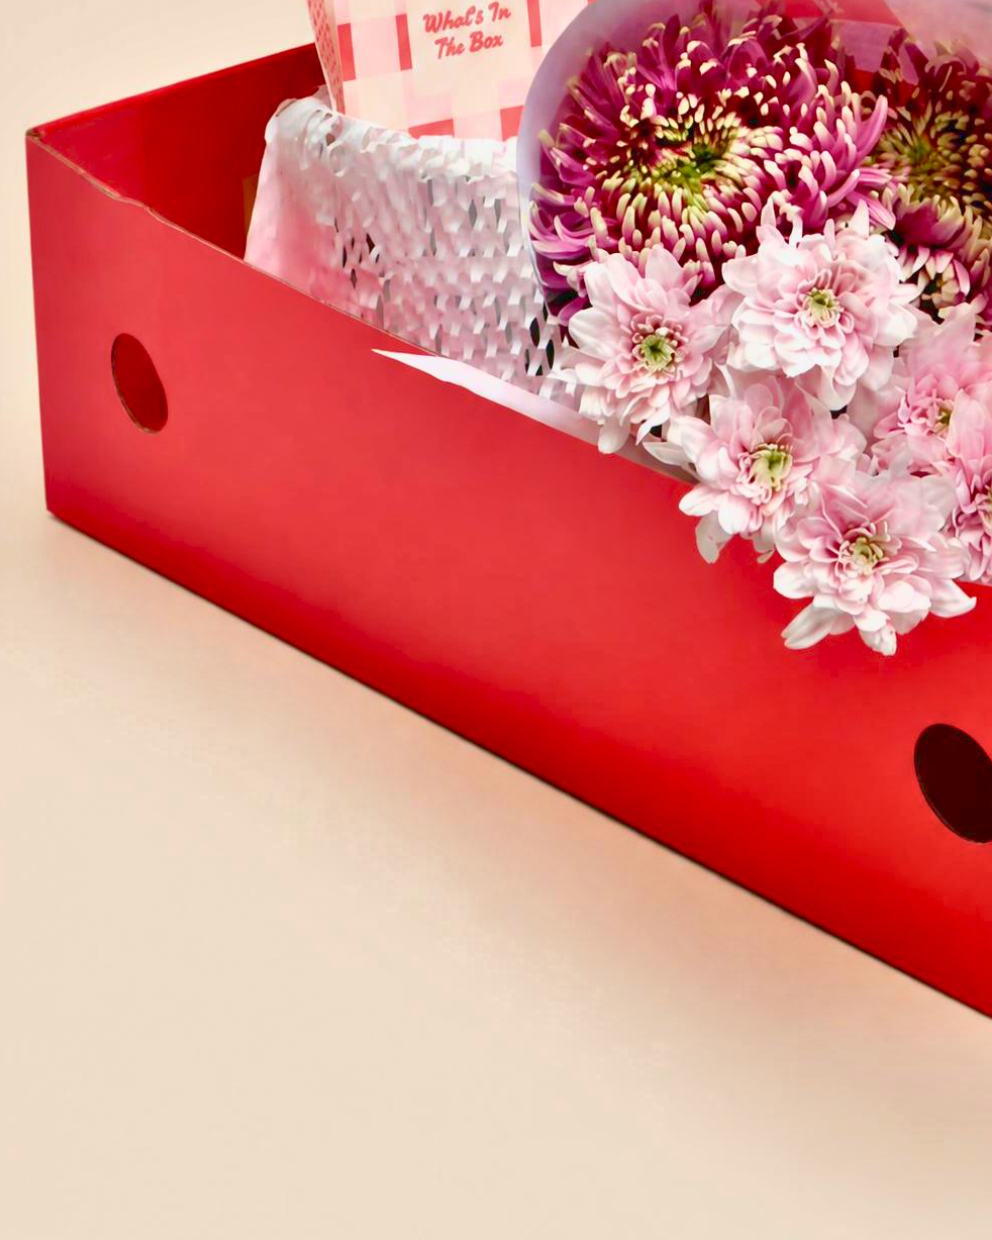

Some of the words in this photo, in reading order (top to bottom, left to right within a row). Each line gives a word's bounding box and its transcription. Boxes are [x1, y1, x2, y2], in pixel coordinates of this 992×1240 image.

[488, 1, 512, 23] In
[434, 36, 466, 60] The
[469, 30, 504, 53] Box
